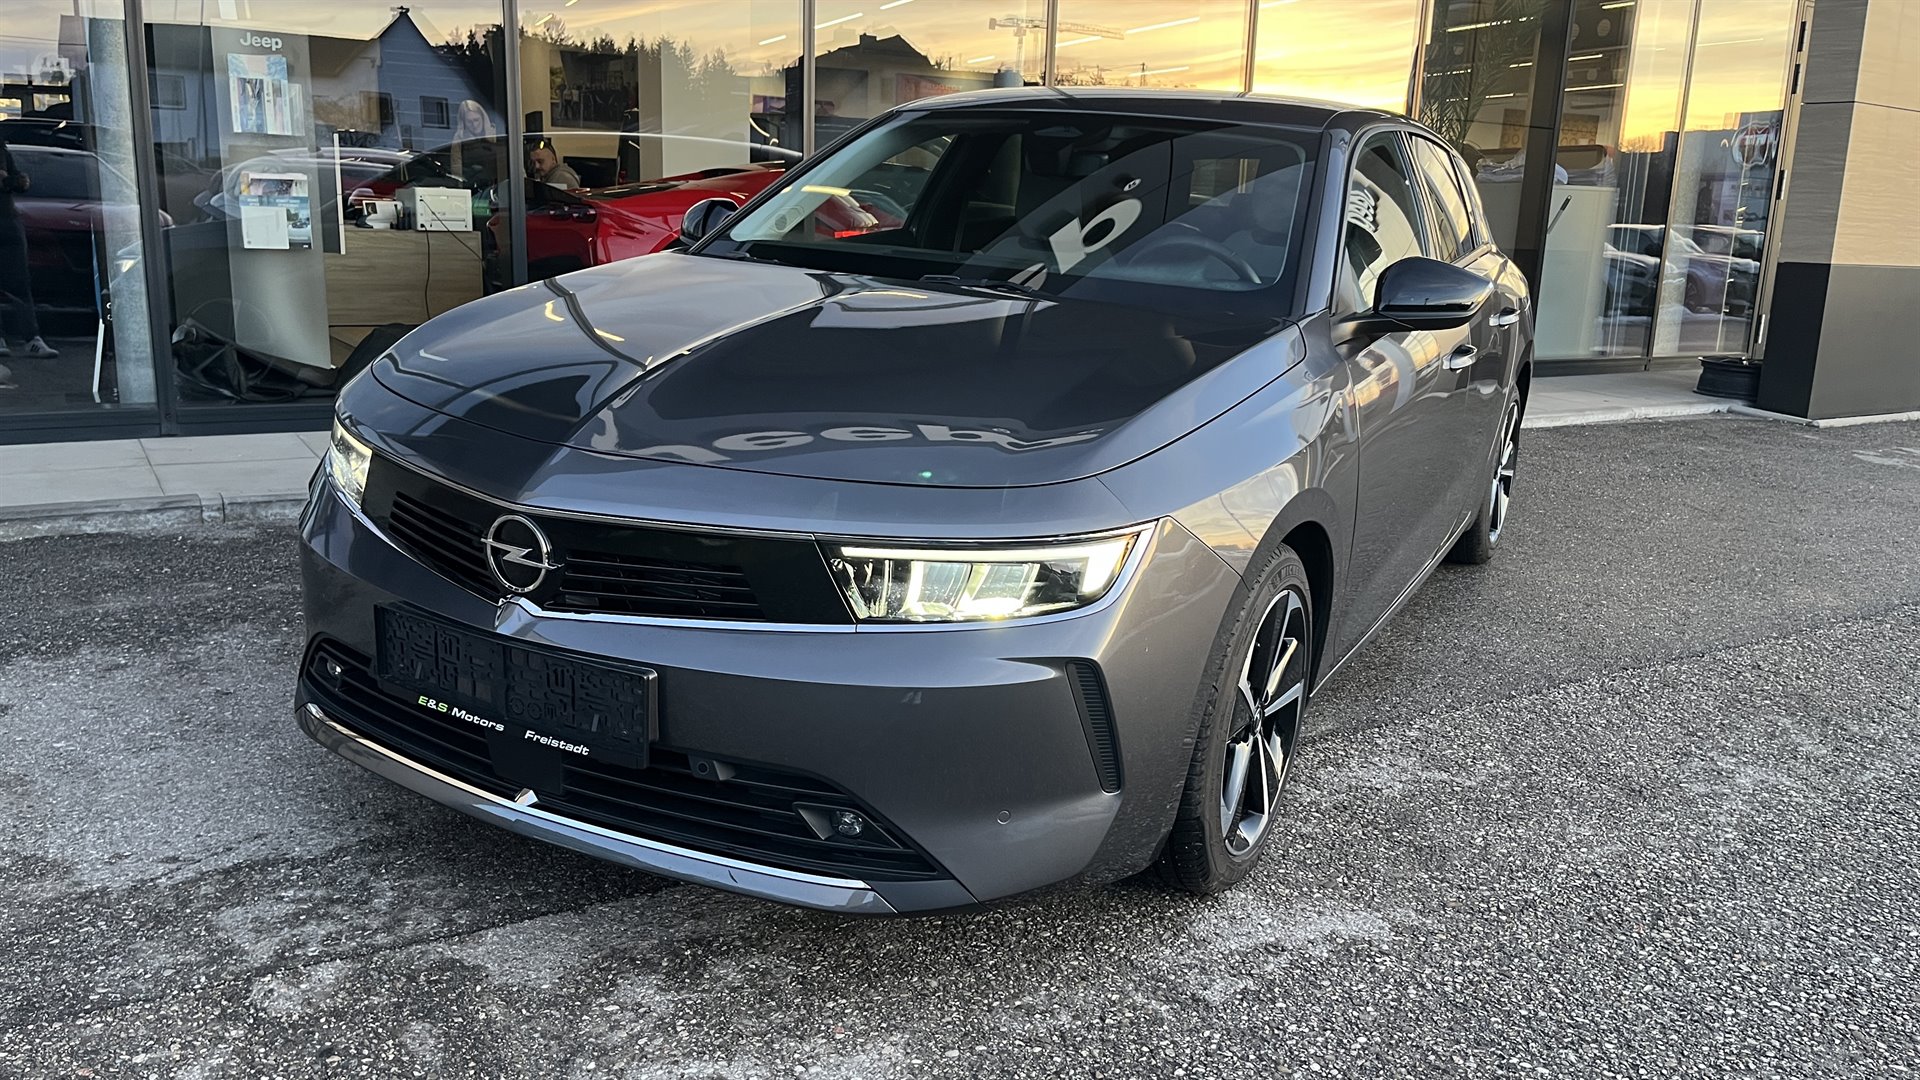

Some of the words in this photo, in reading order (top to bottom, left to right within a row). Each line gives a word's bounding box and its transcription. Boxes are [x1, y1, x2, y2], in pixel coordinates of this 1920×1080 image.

[240, 32, 283, 51] Jeep
[418, 695, 448, 713] E&S
[451, 707, 505, 732] Motors
[524, 730, 590, 756] Freistadt
